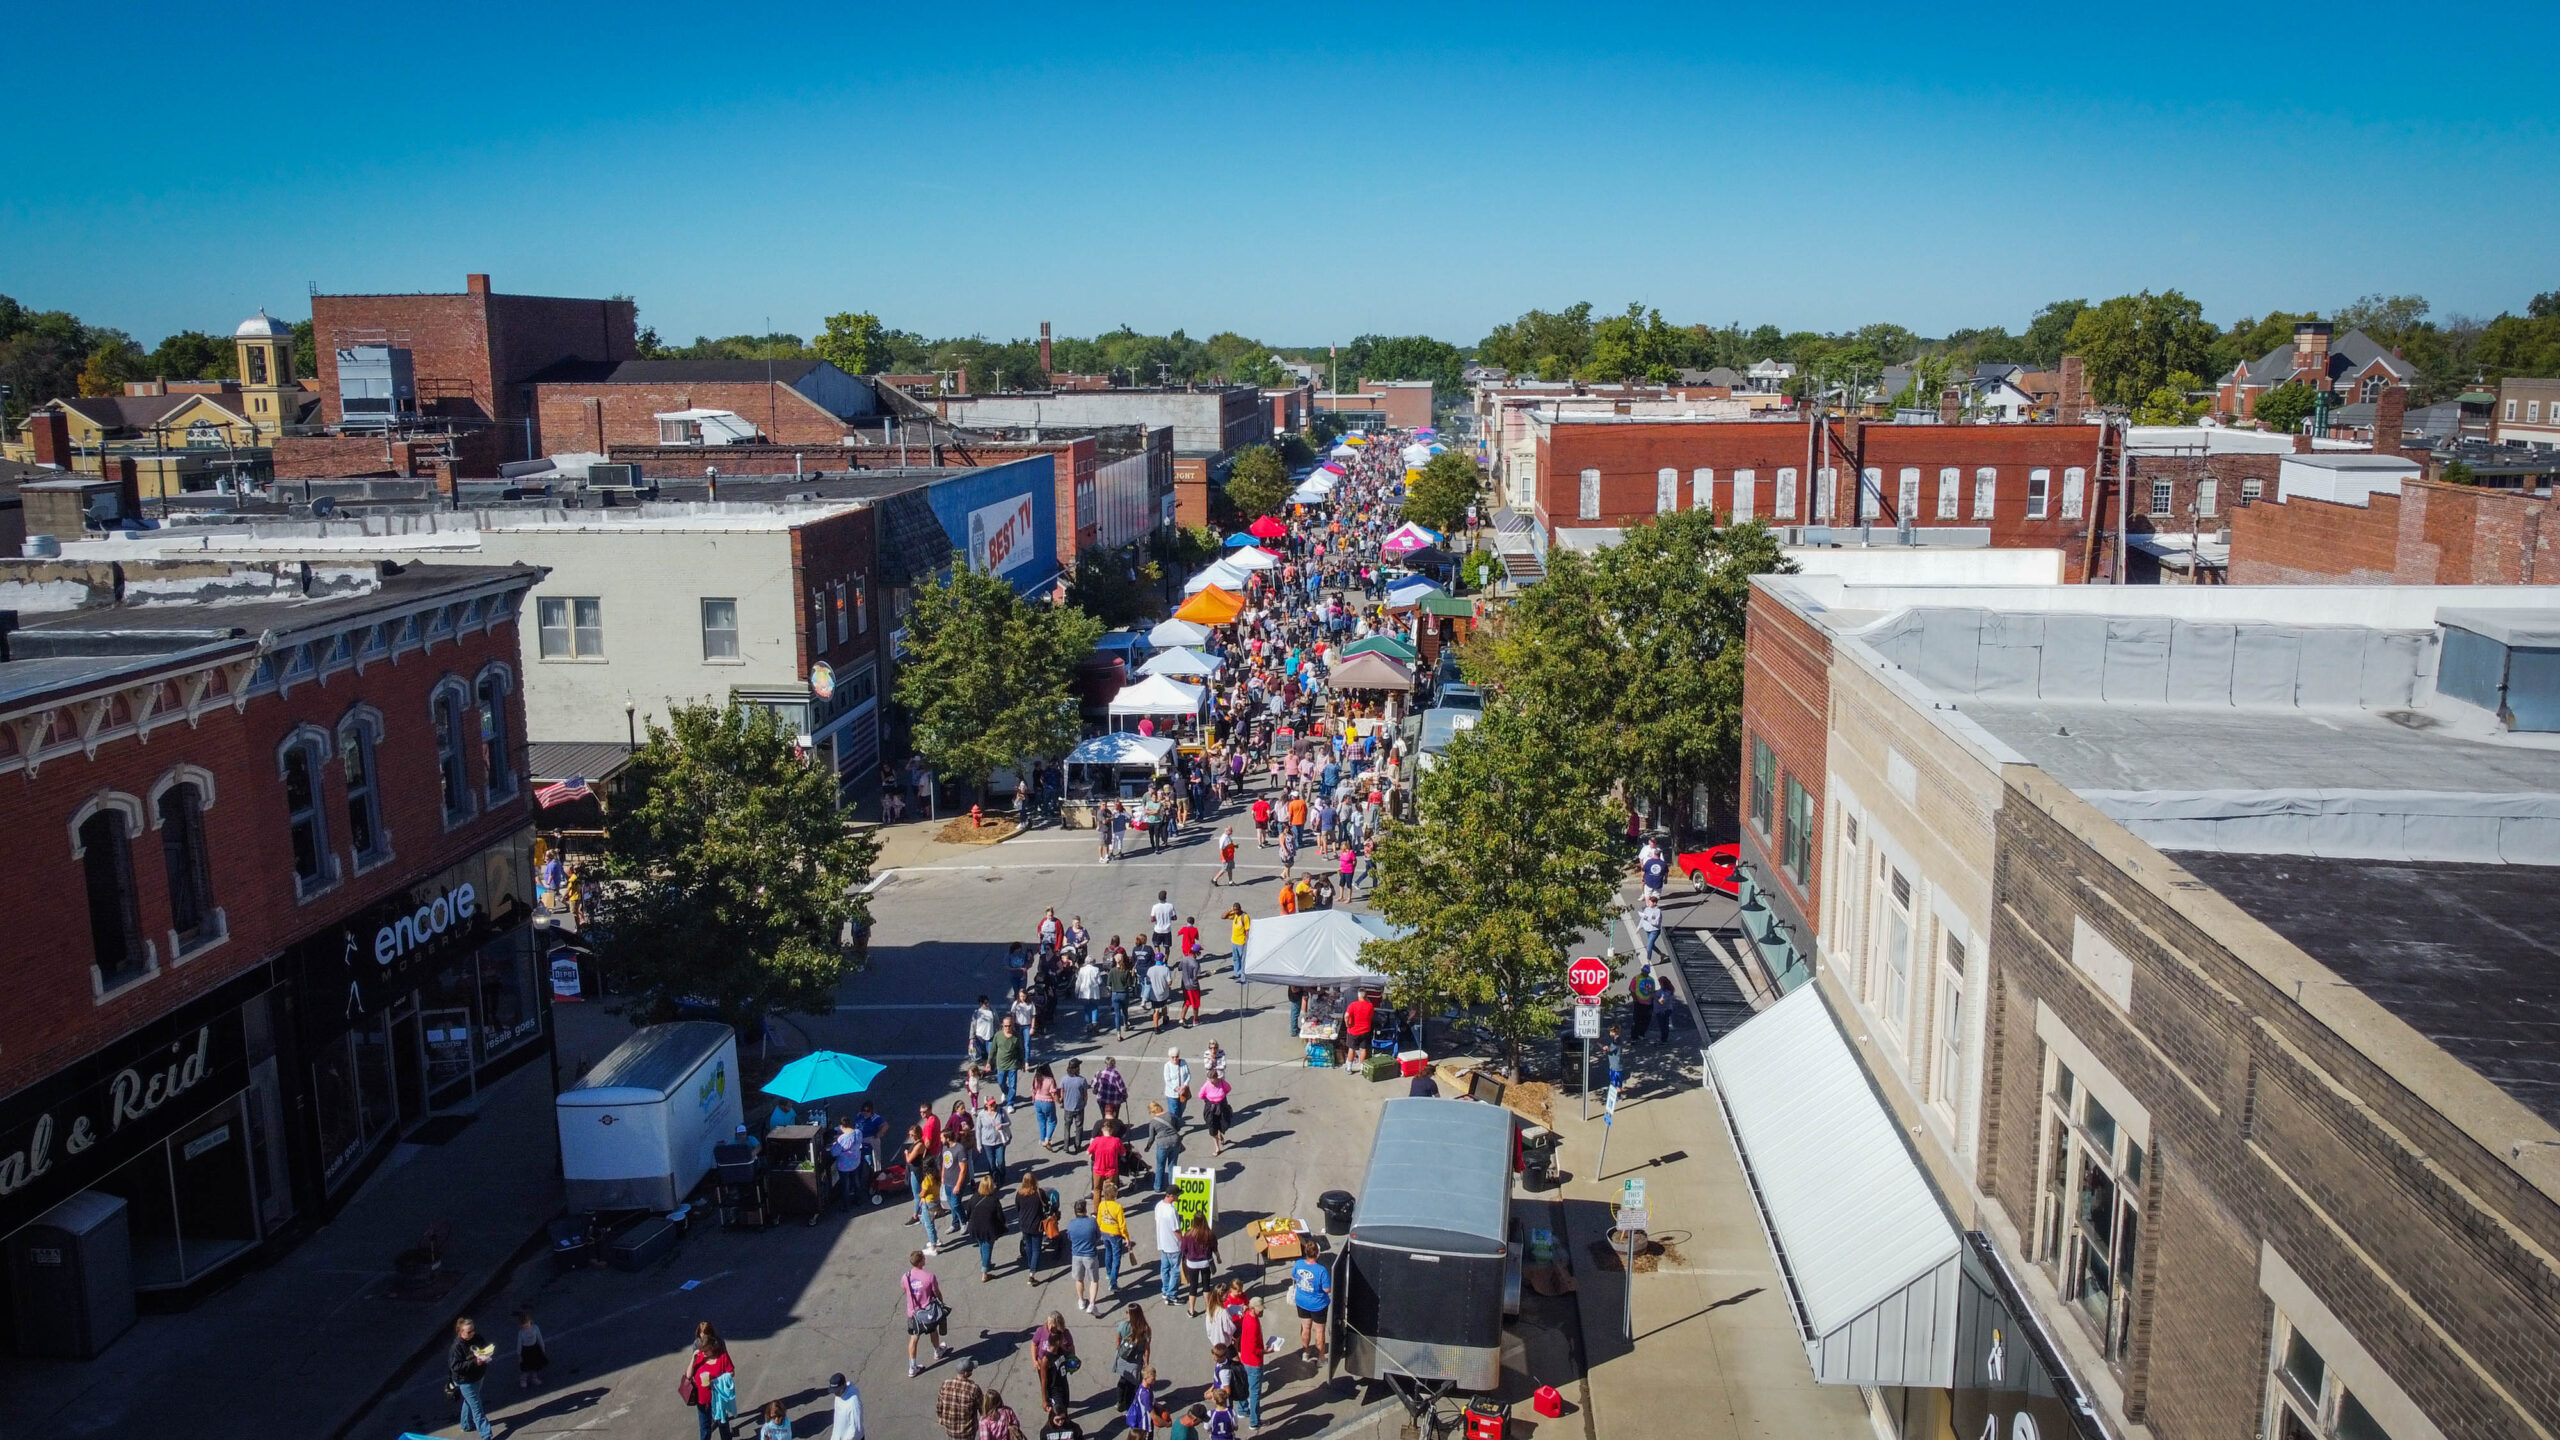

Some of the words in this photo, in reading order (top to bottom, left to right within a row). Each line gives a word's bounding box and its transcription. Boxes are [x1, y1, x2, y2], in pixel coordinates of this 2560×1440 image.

[989, 513, 1016, 572] BEST
[1018, 496, 1031, 536] TV
[374, 882, 475, 966] encore
[1570, 969, 1607, 985] STOP
[1581, 1009, 1594, 1018] NO
[486, 1030, 512, 1051] resale
[514, 1018, 536, 1037] goes
[1577, 1028, 1598, 1036] TURN
[66, 1115, 97, 1155] &
[109, 1025, 214, 1133] Reid
[1181, 1180, 1205, 1194] FOOD
[1176, 1199, 1208, 1213] TRUCK
[1217, 1422, 1226, 1435] 1
